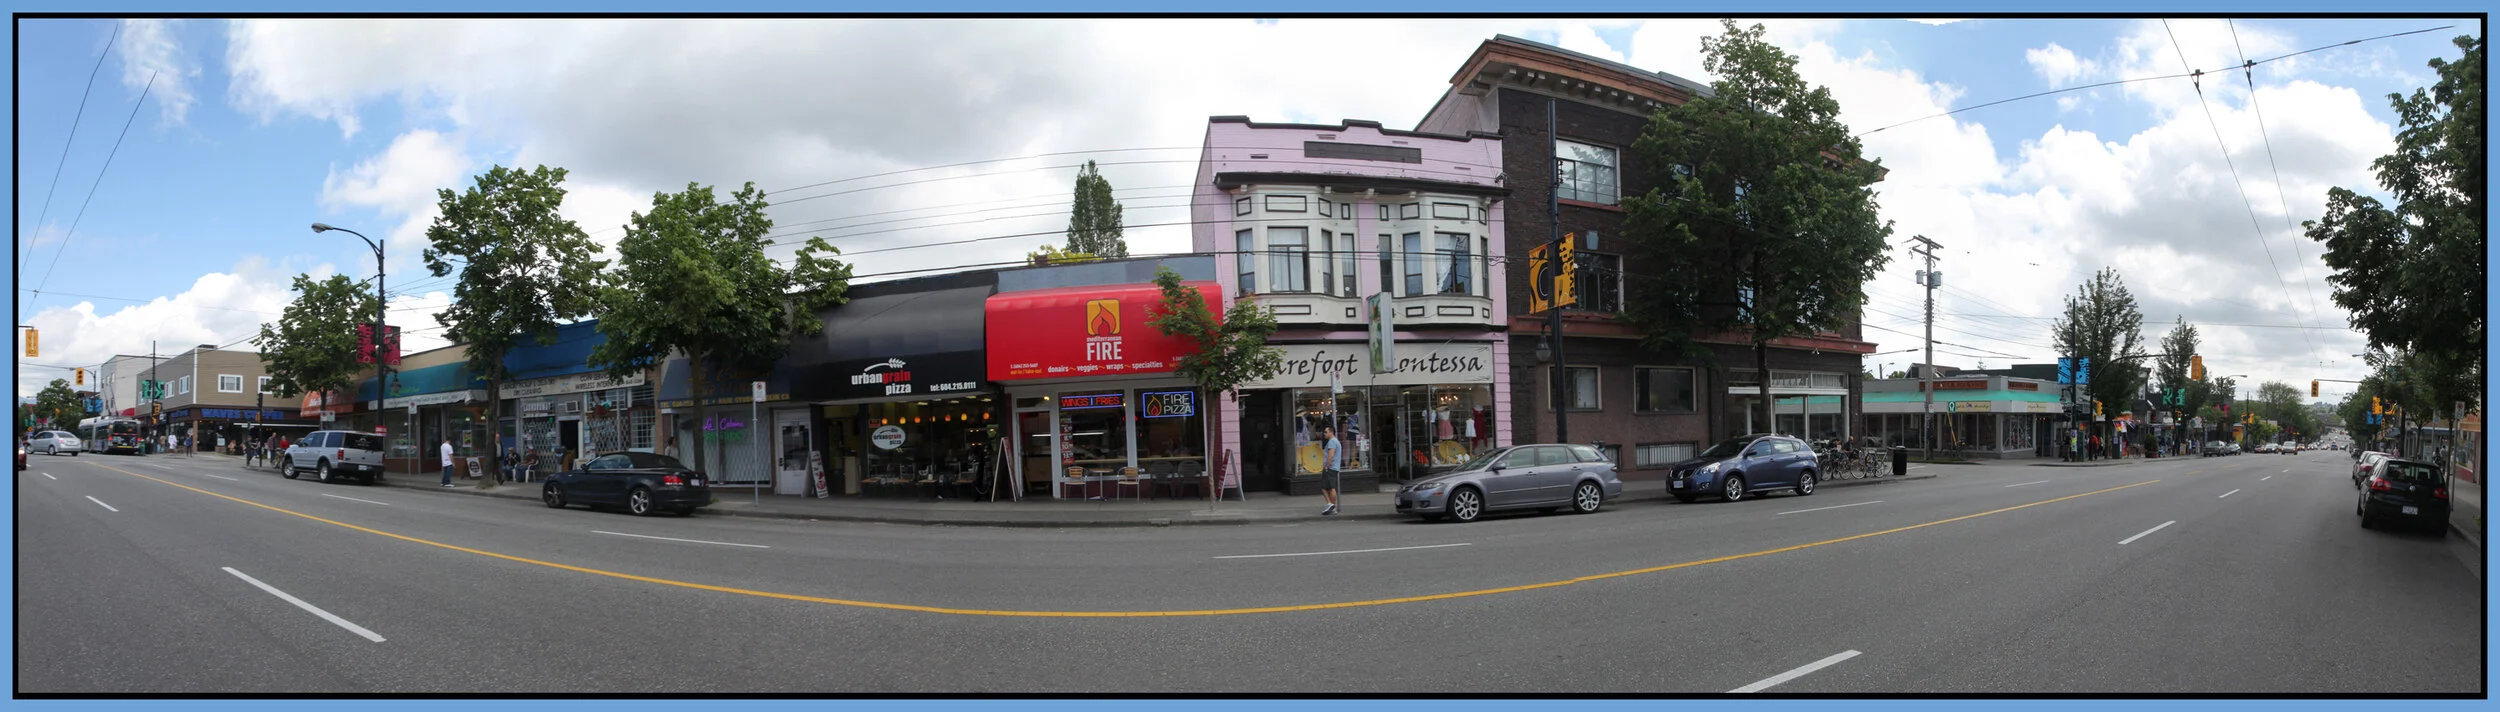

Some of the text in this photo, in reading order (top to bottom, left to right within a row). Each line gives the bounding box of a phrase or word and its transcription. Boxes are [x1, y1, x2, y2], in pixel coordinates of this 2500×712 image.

[1086, 342, 1123, 361] FIRE
[1047, 365, 1069, 373] donairs
[1077, 364, 1099, 372] veggies
[1106, 363, 1124, 371] wraps
[1132, 361, 1163, 369] specialties
[1270, 350, 1483, 384] arefoot ontessa
[885, 382, 912, 396] pizza
[1061, 396, 1120, 407] WINGS FRIES
[1163, 394, 1190, 405] FIRE
[201, 408, 241, 419] WAVES
[244, 409, 284, 419] COFEE
[1163, 404, 1192, 414] PIZZA
